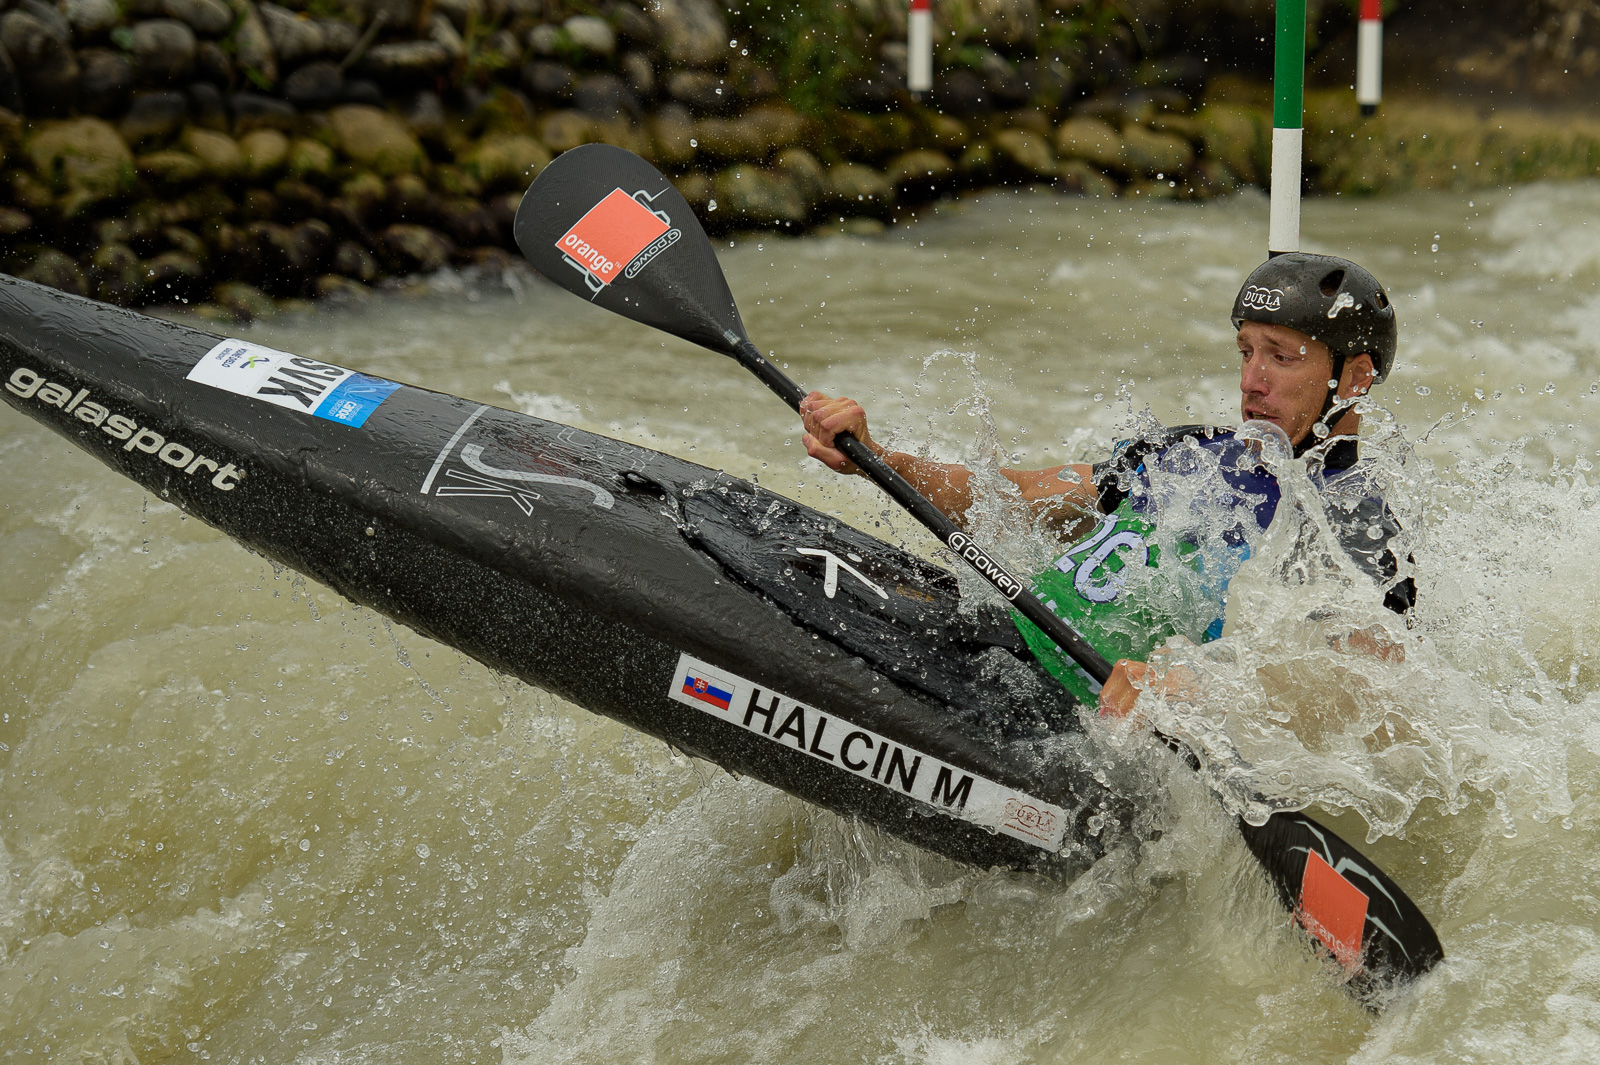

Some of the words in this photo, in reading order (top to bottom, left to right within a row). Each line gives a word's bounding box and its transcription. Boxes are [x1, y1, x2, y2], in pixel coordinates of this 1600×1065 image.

[564, 233, 614, 274] orange
[1244, 290, 1281, 307] DUKLA
[256, 357, 345, 408] SVK
[4, 367, 242, 491] galasport
[334, 400, 357, 420] canoe
[742, 688, 922, 794] HALCIN
[931, 764, 975, 812] M
